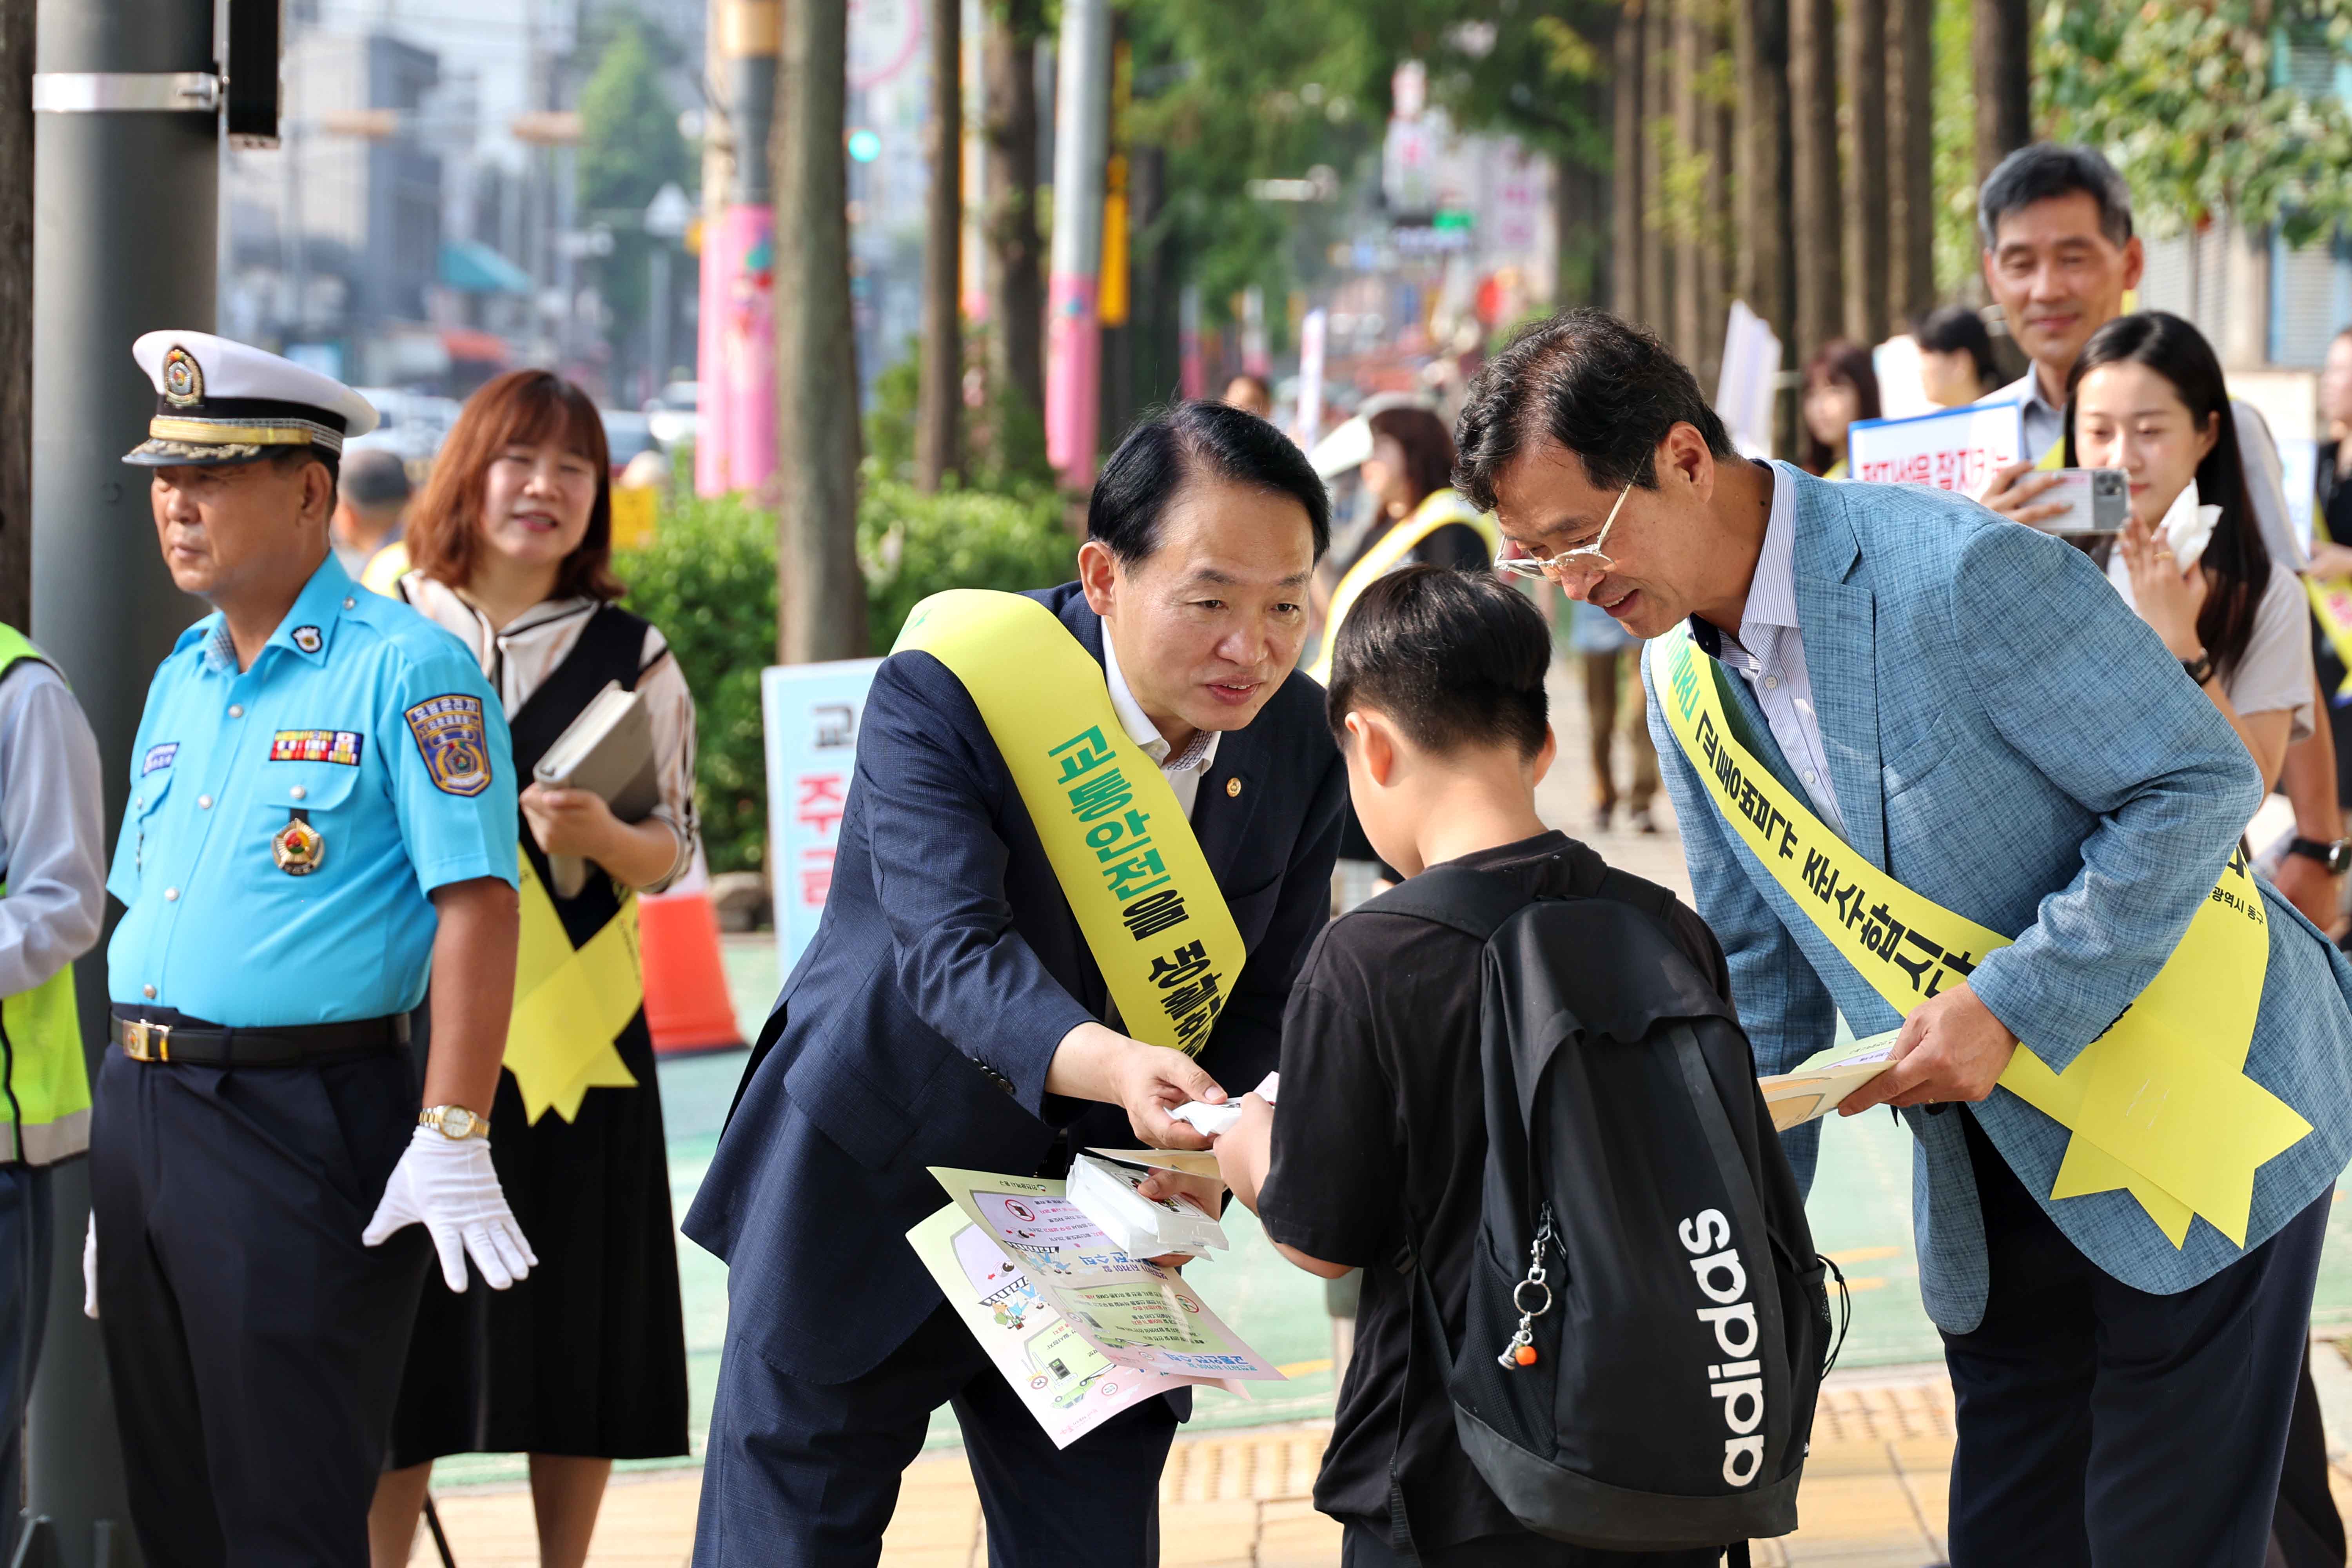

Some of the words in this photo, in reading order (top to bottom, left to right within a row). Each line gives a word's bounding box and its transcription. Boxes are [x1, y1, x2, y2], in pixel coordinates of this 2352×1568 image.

[813, 705, 855, 749] 교
[800, 775, 843, 833] 주
[1695, 709, 1798, 860] 교통법규
[1047, 724, 1189, 941] 교통안전을
[2207, 886, 2245, 914] 광역시
[2247, 904, 2264, 926] 동구
[1192, 1355, 1249, 1365] 교통안전
[1679, 1208, 1764, 1486] adidas
